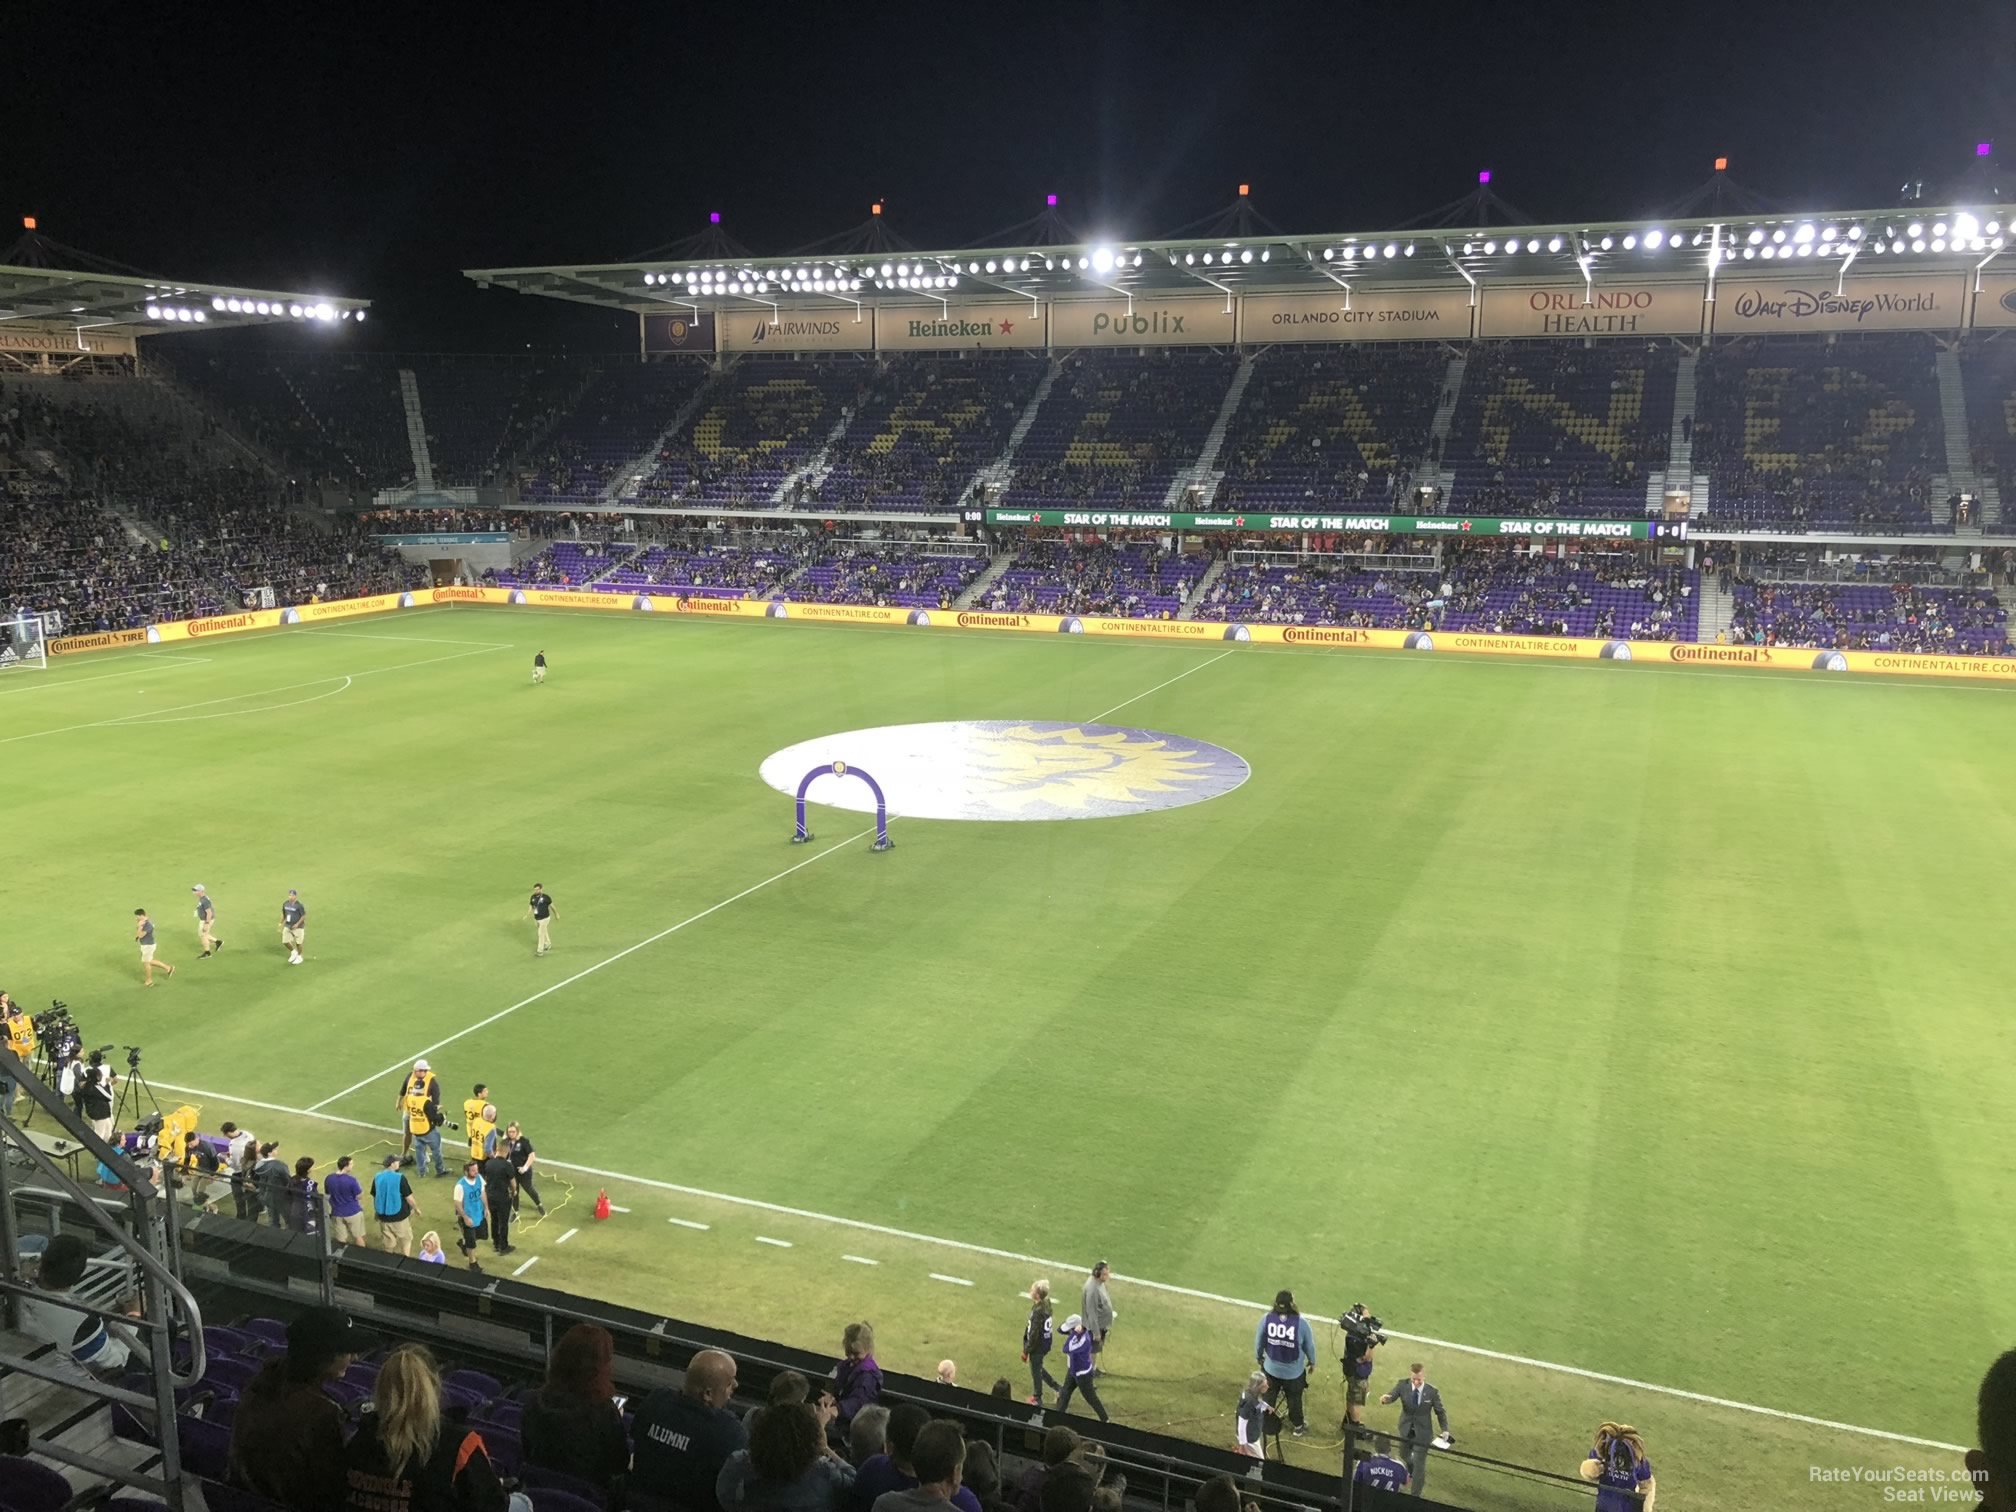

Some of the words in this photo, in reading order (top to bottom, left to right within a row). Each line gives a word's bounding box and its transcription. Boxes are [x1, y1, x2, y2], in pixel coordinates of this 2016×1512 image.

[1875, 292, 1935, 312] World
[1093, 310, 1184, 335] Publix
[1272, 312, 1339, 325] ORLANDO
[1344, 311, 1374, 323] CITY
[1378, 310, 1440, 322] STADIUM
[1543, 314, 1638, 333] HEALTH
[767, 321, 840, 336] FAIRWINDS
[908, 319, 992, 337] Heineken
[53, 336, 105, 352] HETH
[1064, 513, 1090, 525] STAR
[1091, 513, 1107, 525] OF
[1109, 514, 1130, 526] THE
[1131, 515, 1171, 526] MATCH
[1270, 517, 1299, 529] STAR
[1301, 517, 1319, 529] OF
[1321, 518, 1344, 530] THE
[1345, 518, 1389, 530] MATCH
[1500, 522, 1532, 534] STAR
[1533, 522, 1554, 535] OF
[1555, 522, 1581, 535] THE
[1583, 523, 1632, 536] MATCH
[433, 588, 478, 602] Continental
[539, 594, 619, 605] CONTINENTALTIRE.COM
[312, 599, 386, 616] CONTINENTALTIRE.COM
[676, 598, 732, 612] Cntinental
[802, 607, 891, 619] CONTINENTALTIRE.COM
[957, 612, 1020, 627] Continental
[187, 615, 247, 637] Continental
[1101, 622, 1205, 635] CONTINENTALTIRE.COM
[1282, 626, 1358, 644] Continental
[51, 634, 111, 655] Continental
[121, 632, 144, 642] TIRE
[1455, 638, 1578, 652] CONTINENTALTIRE.COM
[1669, 644, 1758, 663] Continental
[14, 1028, 32, 1041] 072
[1268, 1322, 1295, 1341] 004
[647, 1423, 690, 1452] ALUMNI
